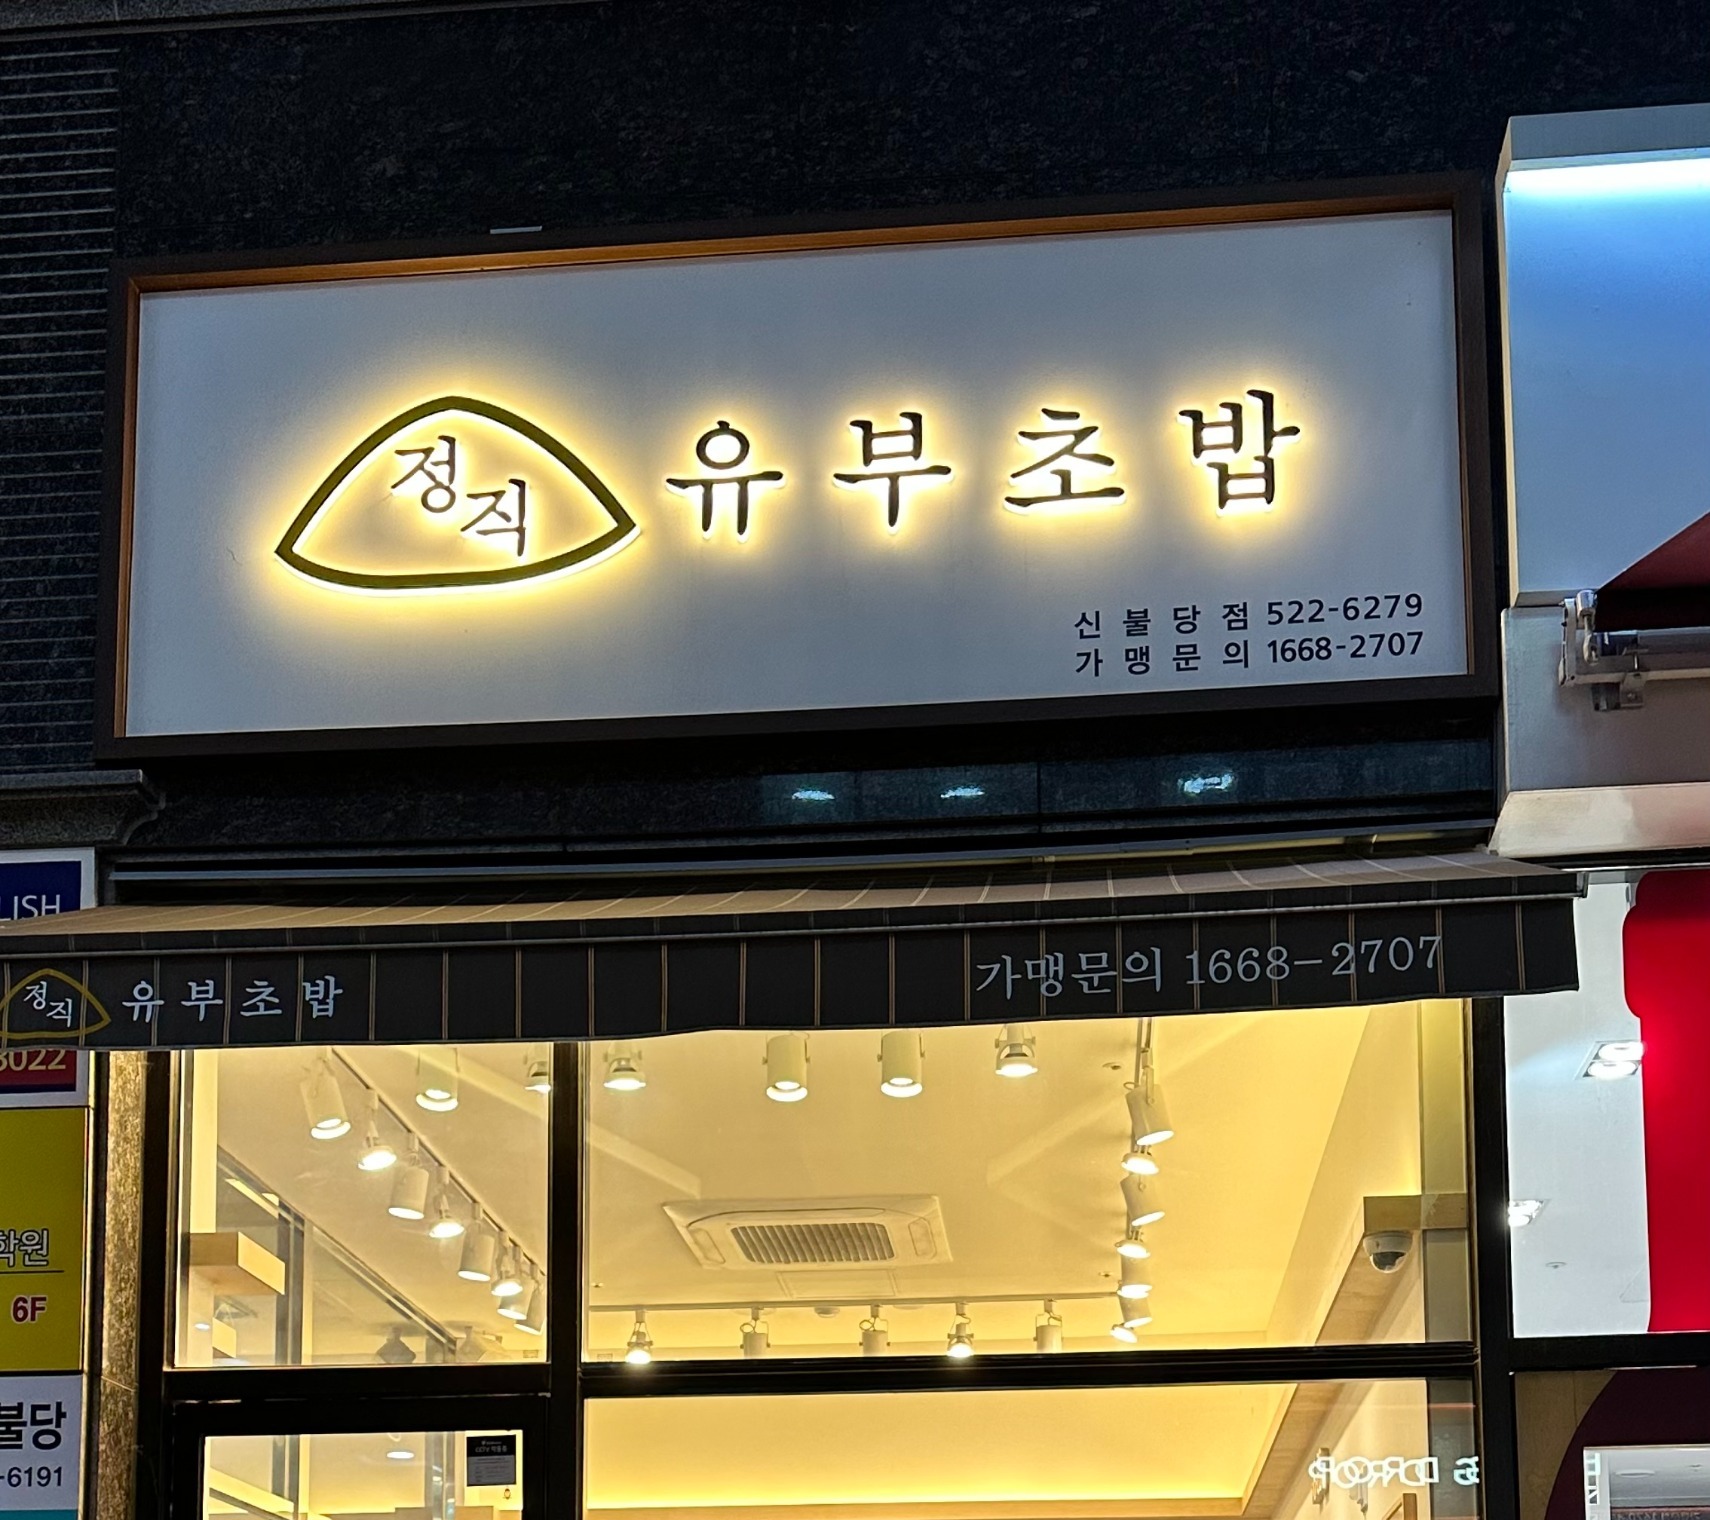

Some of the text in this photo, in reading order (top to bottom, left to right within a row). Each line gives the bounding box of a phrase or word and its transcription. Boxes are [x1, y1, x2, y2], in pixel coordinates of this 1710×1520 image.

[391, 389, 1301, 557] 정직 유부초밥
[1267, 593, 1424, 626] 522-6279
[1267, 631, 1424, 663] 1668-2707
[976, 935, 1442, 1000] 가맹문의 1668-2707
[23, 974, 344, 1028] 정직 유부초밥
[12, 1296, 47, 1323] 6F
